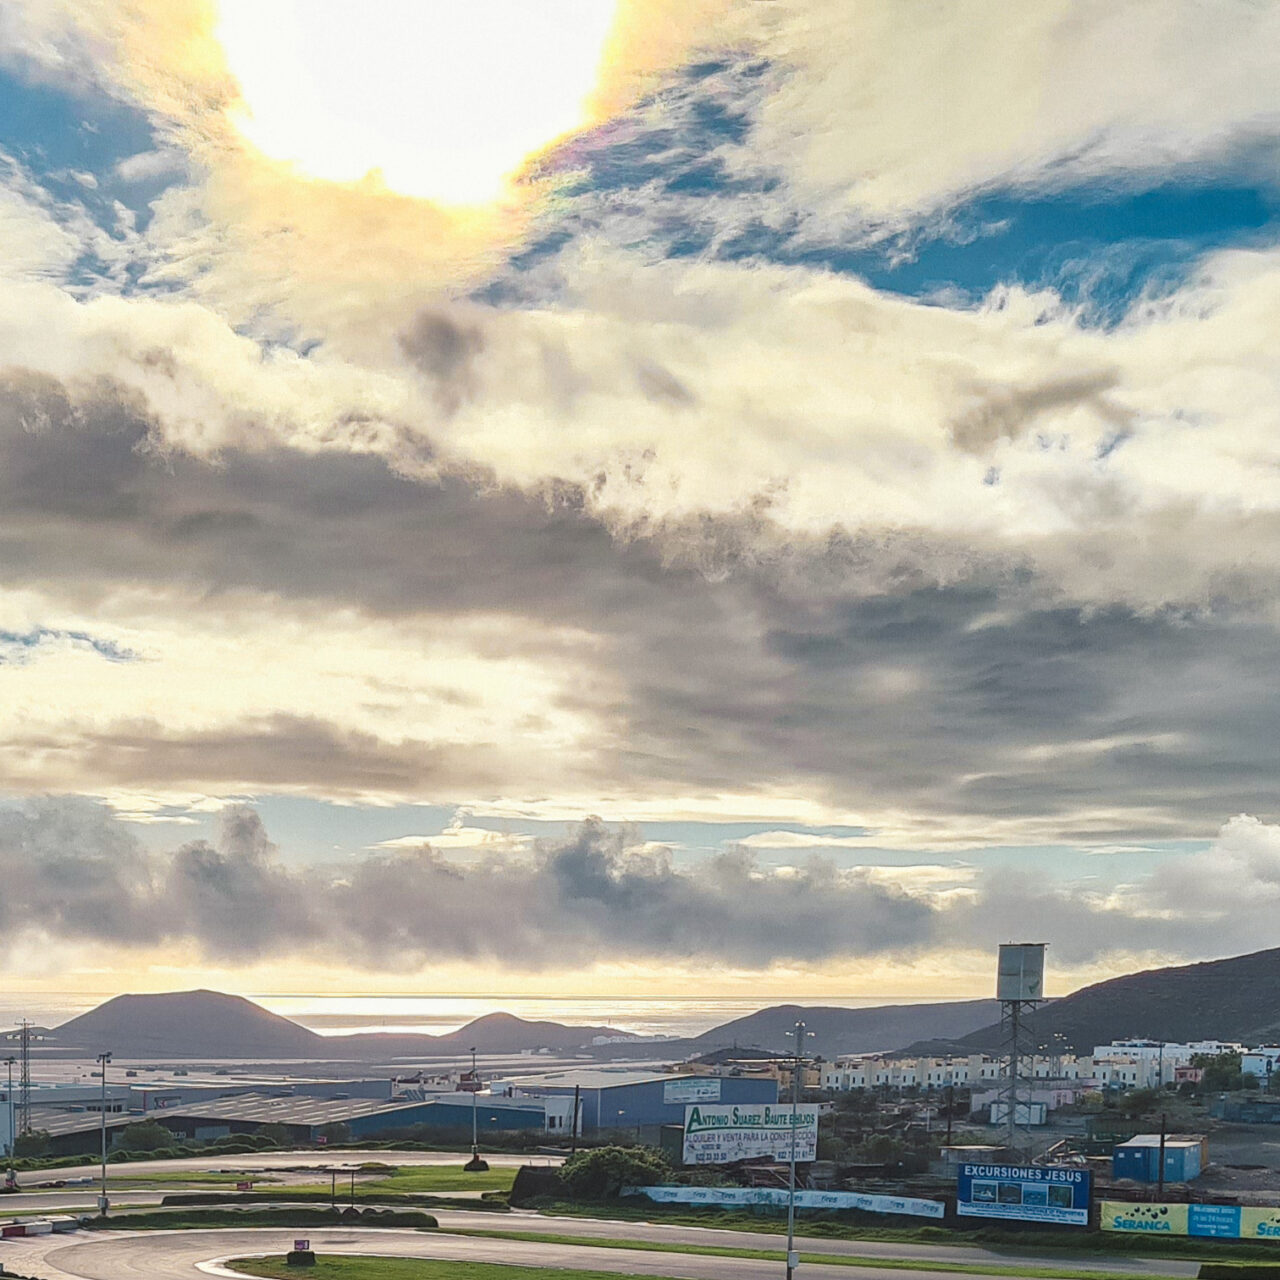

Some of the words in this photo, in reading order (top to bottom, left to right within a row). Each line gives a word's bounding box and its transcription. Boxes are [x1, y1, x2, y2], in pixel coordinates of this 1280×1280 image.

[732, 1107, 761, 1125] SUAREZ
[764, 1106, 787, 1125] BAUTE
[722, 1133, 742, 1142] VENTA
[743, 1133, 760, 1142] PARA
[761, 1133, 768, 1141] LA
[964, 1165, 1042, 1180] EXCURSIONES
[1112, 1215, 1171, 1231] SERANCA
